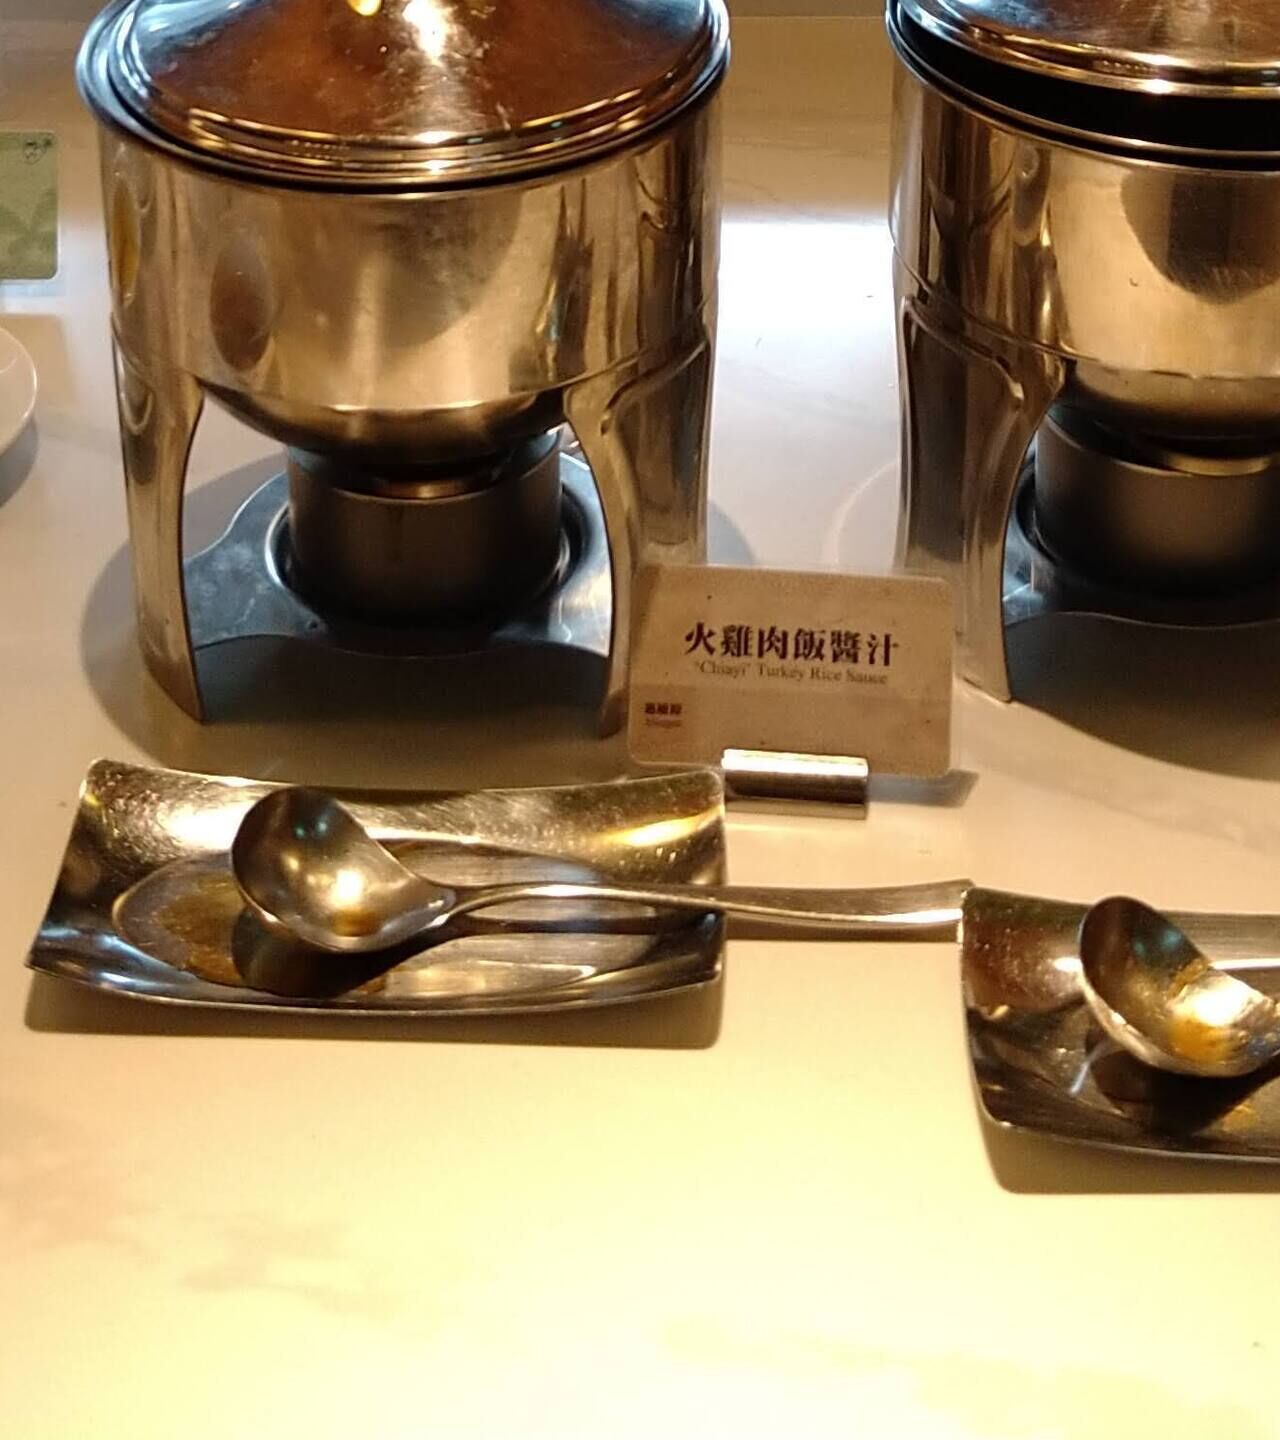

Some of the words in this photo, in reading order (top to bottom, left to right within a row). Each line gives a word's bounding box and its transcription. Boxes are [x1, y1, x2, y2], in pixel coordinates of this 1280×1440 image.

[683, 621, 900, 667] 火雞肉飯醬汁
[757, 662, 804, 682] Turkey
[810, 666, 842, 682] Rice
[846, 668, 888, 685] Sauce
